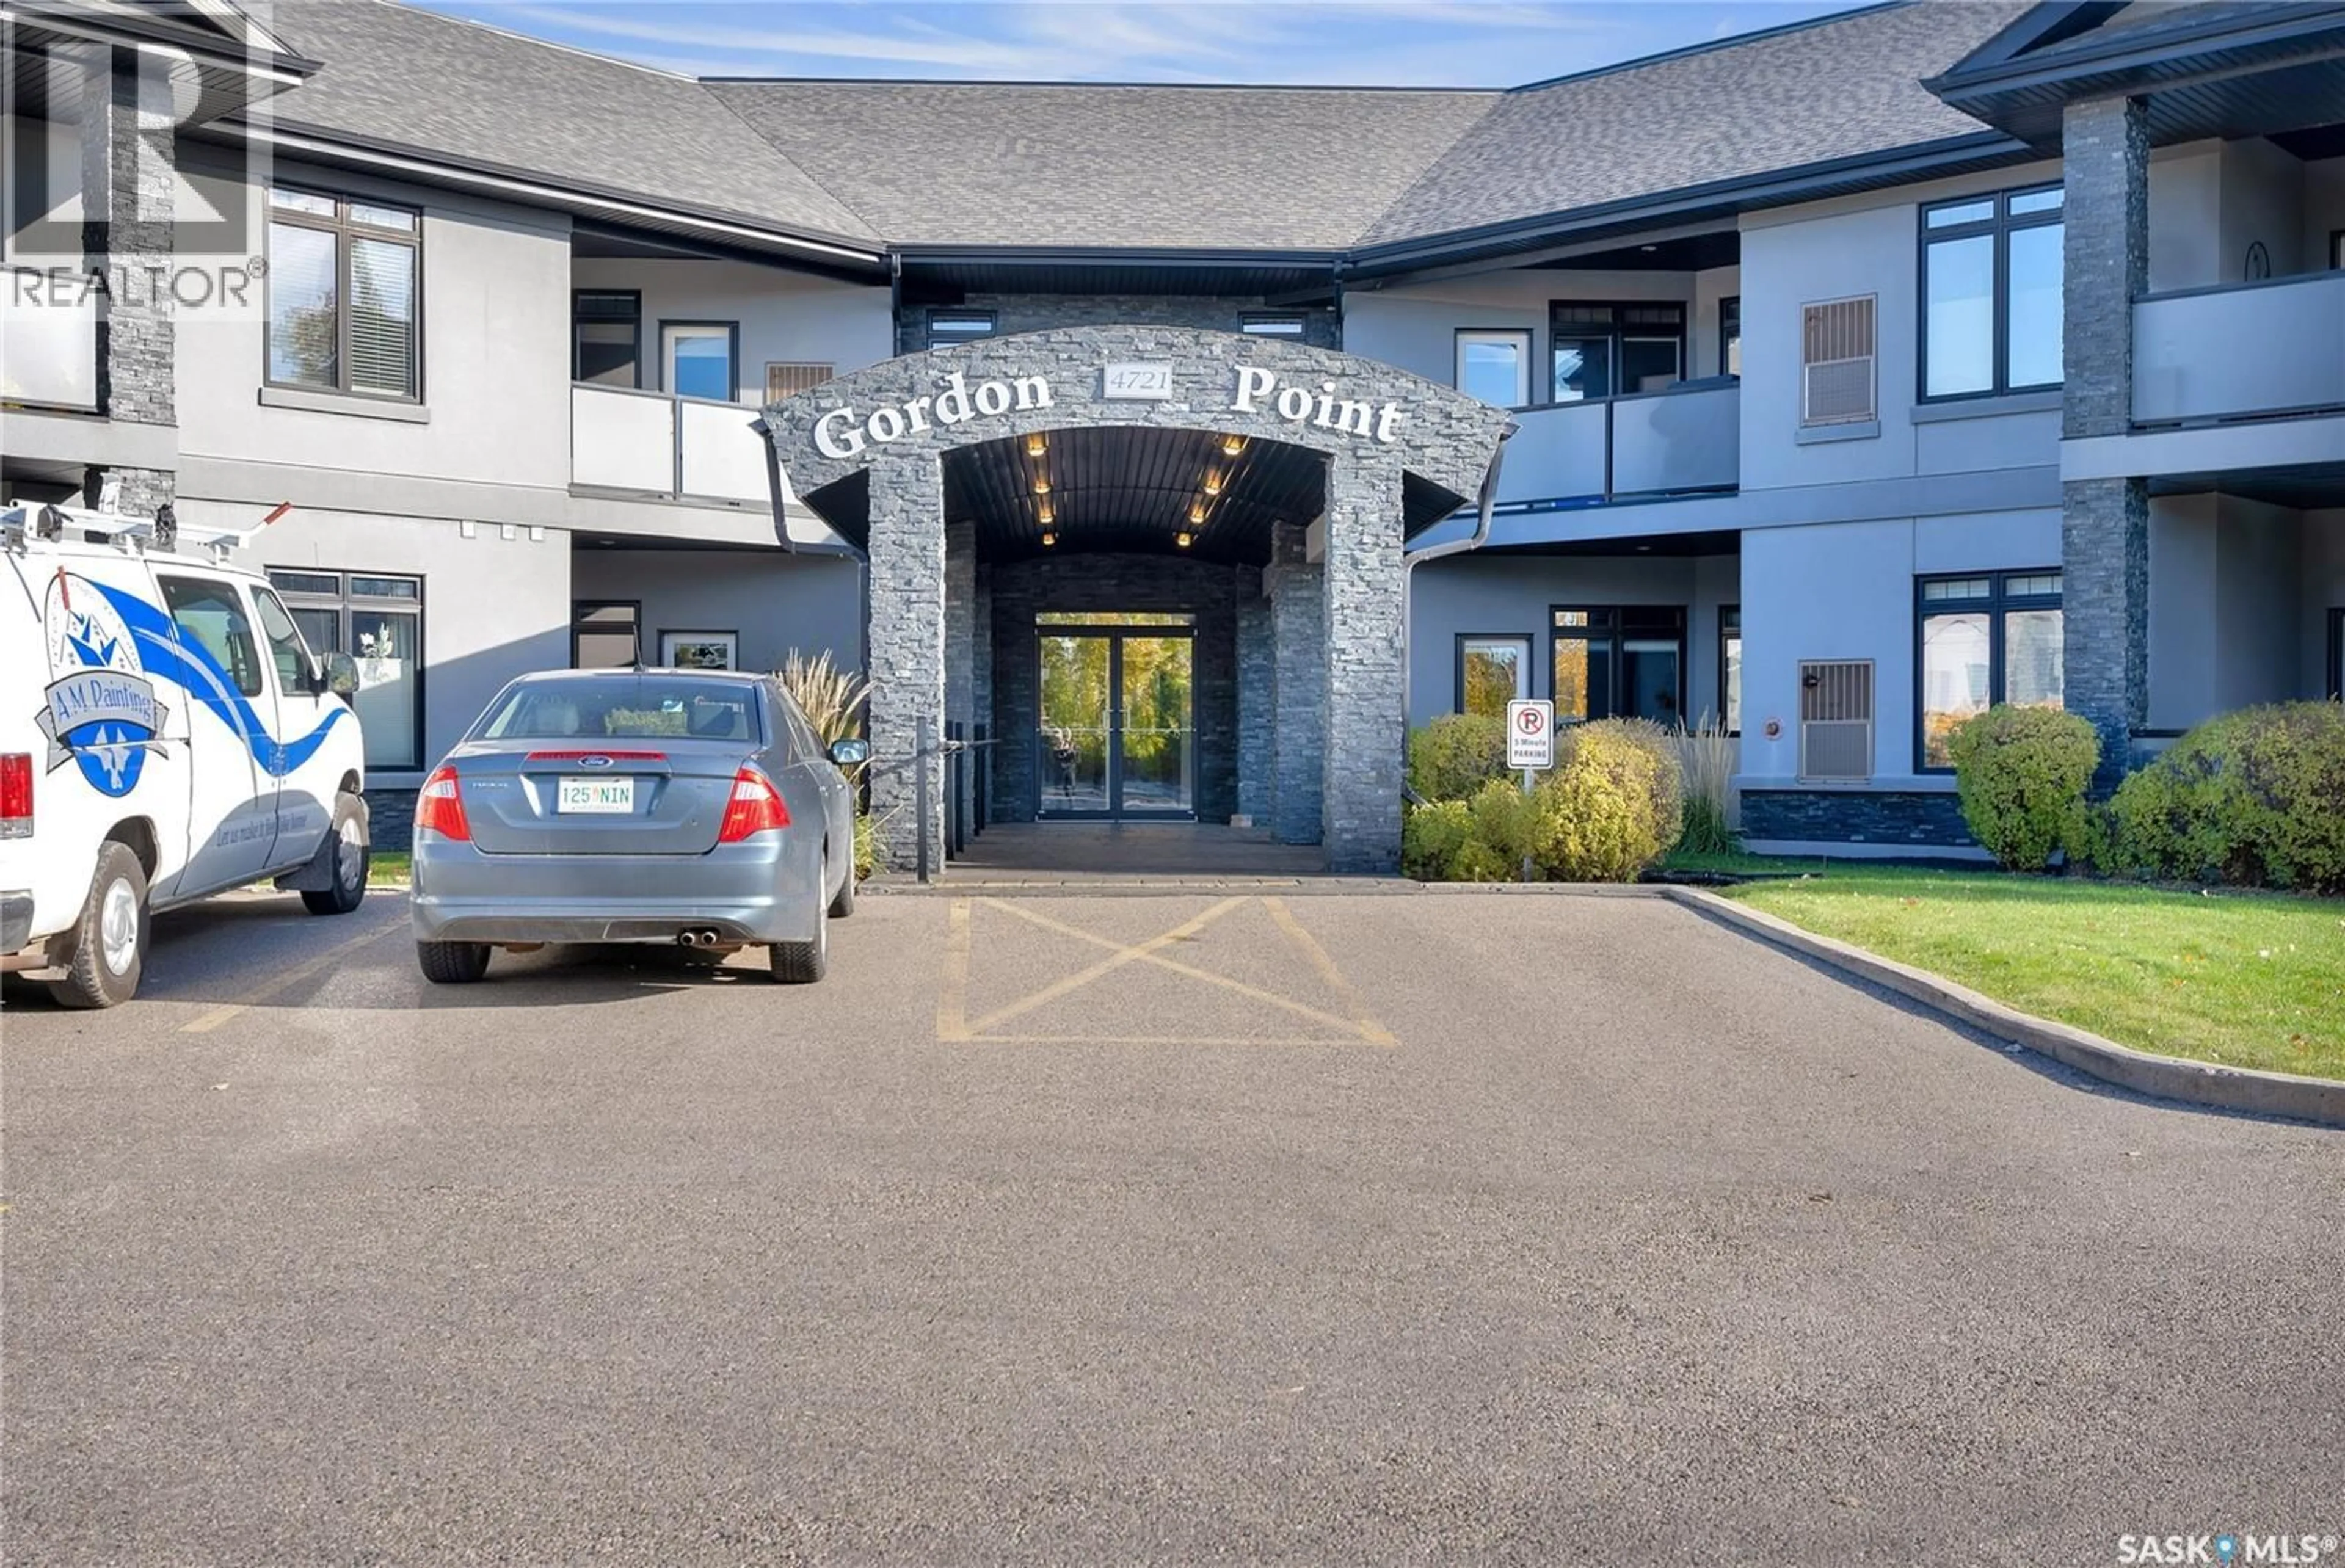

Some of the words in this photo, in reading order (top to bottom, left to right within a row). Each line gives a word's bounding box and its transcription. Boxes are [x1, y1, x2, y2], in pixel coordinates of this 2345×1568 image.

[1110, 371, 1167, 390] 4721
[814, 371, 1054, 459] Gordon
[1229, 366, 1403, 443] Point
[90, 679, 151, 722] Painting
[564, 787, 591, 803] 125
[600, 787, 629, 803] NIN
